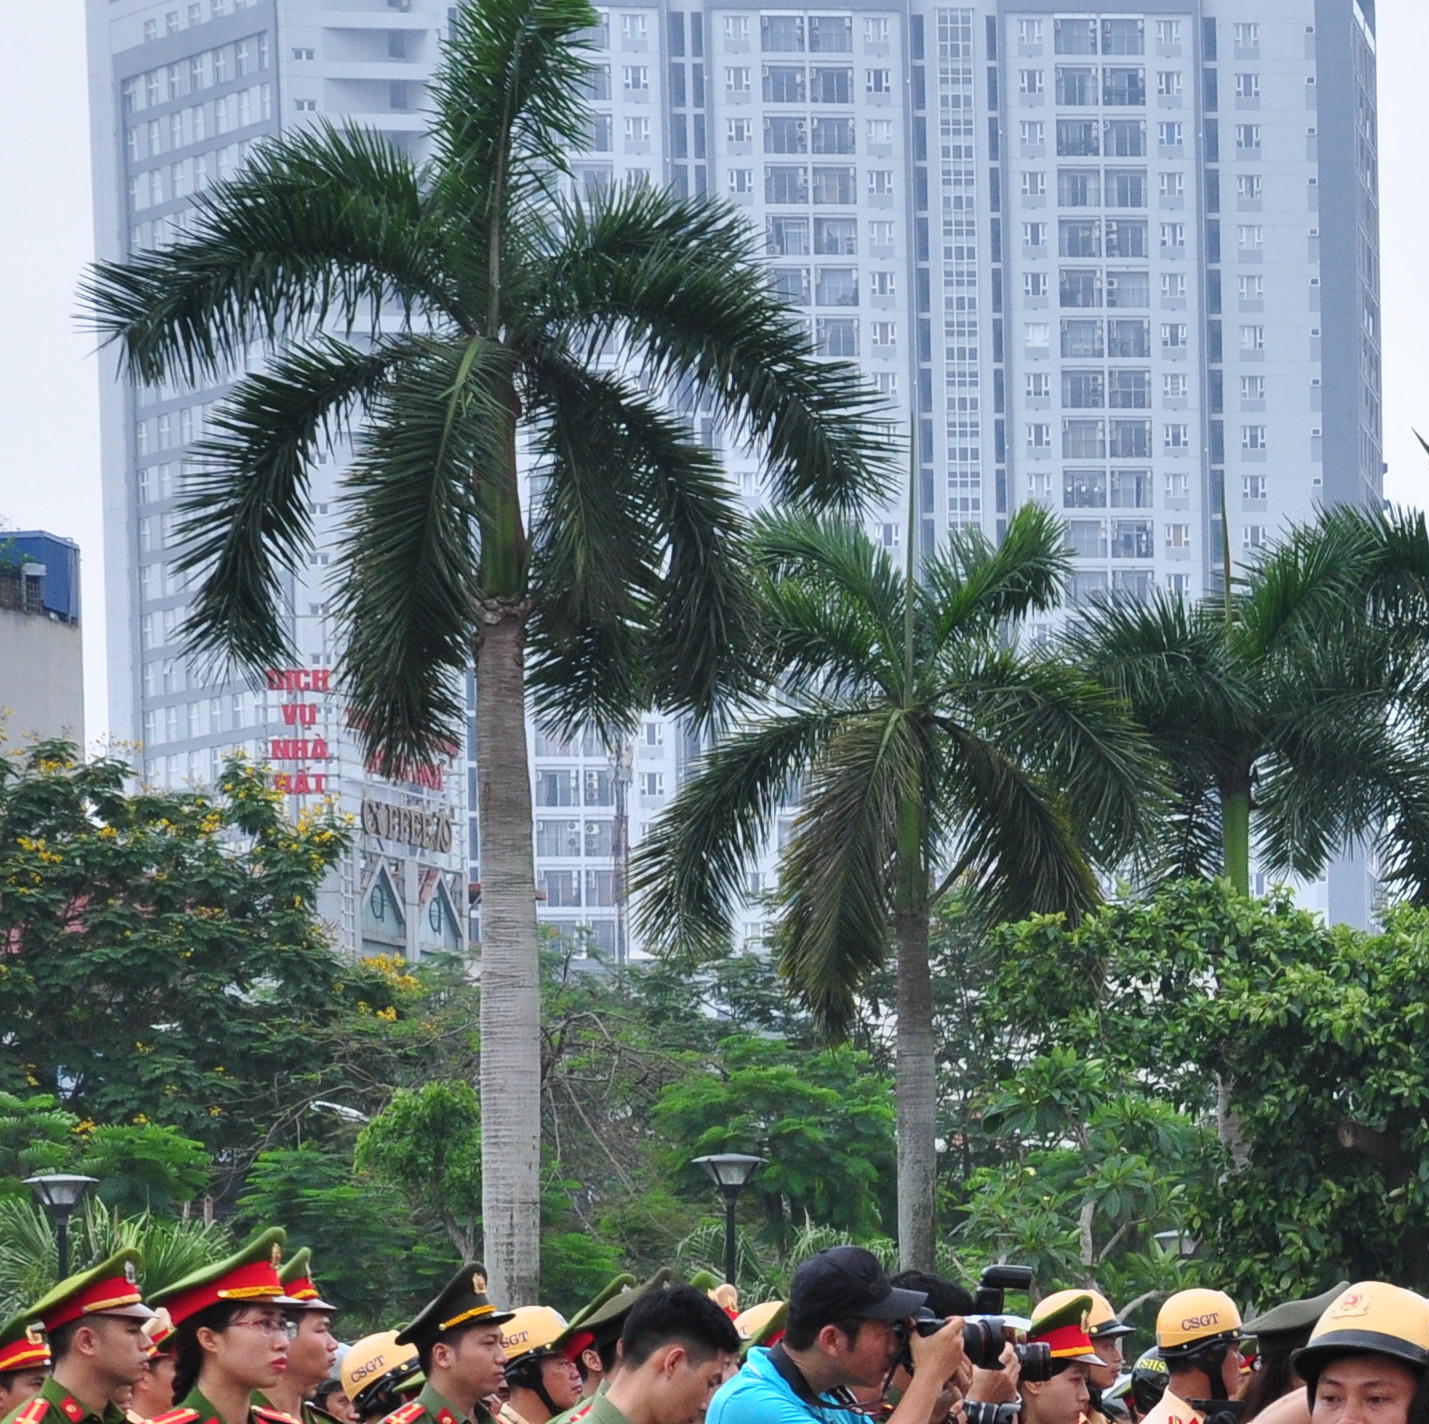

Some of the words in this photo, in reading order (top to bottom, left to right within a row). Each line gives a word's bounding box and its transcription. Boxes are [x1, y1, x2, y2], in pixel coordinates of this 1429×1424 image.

[282, 703, 317, 731] VỤ
[271, 733, 328, 760] NHÀ
[1181, 1312, 1219, 1331] CSGT
[500, 1331, 529, 1349] SGT
[350, 1354, 385, 1383] CSGT
